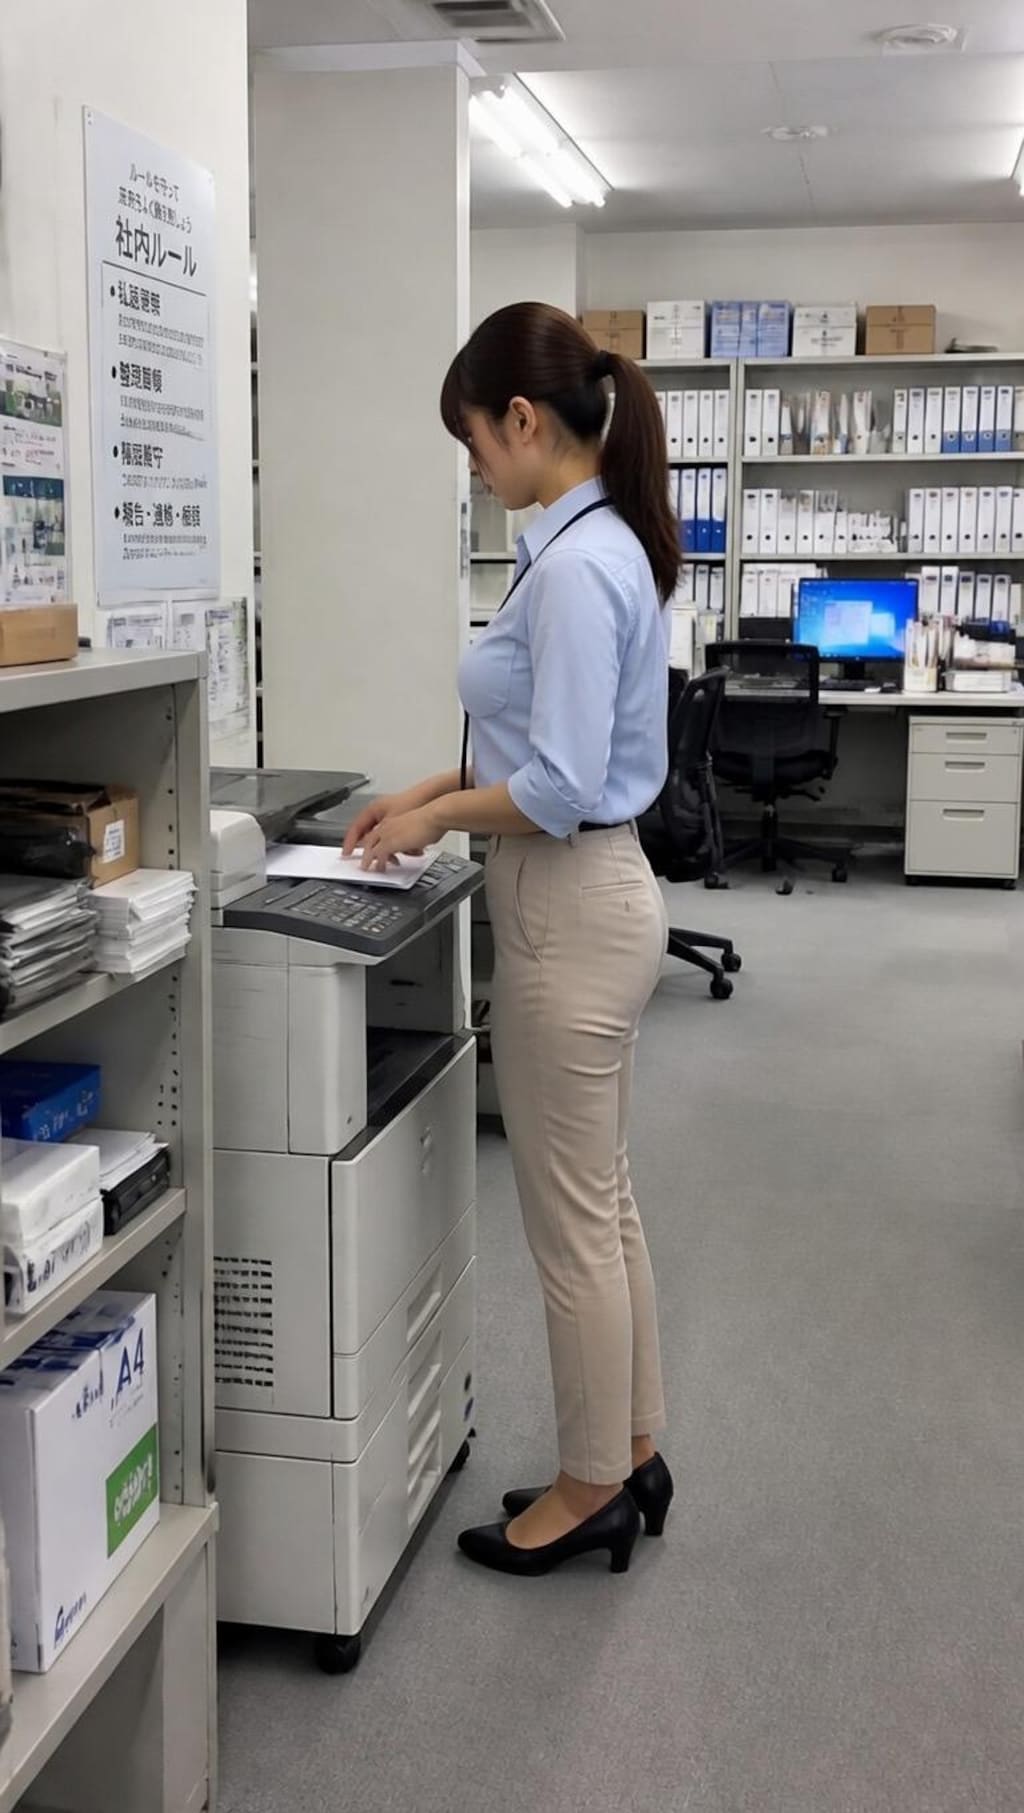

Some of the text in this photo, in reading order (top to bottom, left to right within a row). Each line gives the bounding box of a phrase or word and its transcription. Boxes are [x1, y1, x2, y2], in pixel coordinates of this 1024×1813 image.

[115, 214, 197, 277] 社内ルール
[116, 1326, 144, 1394] A4
